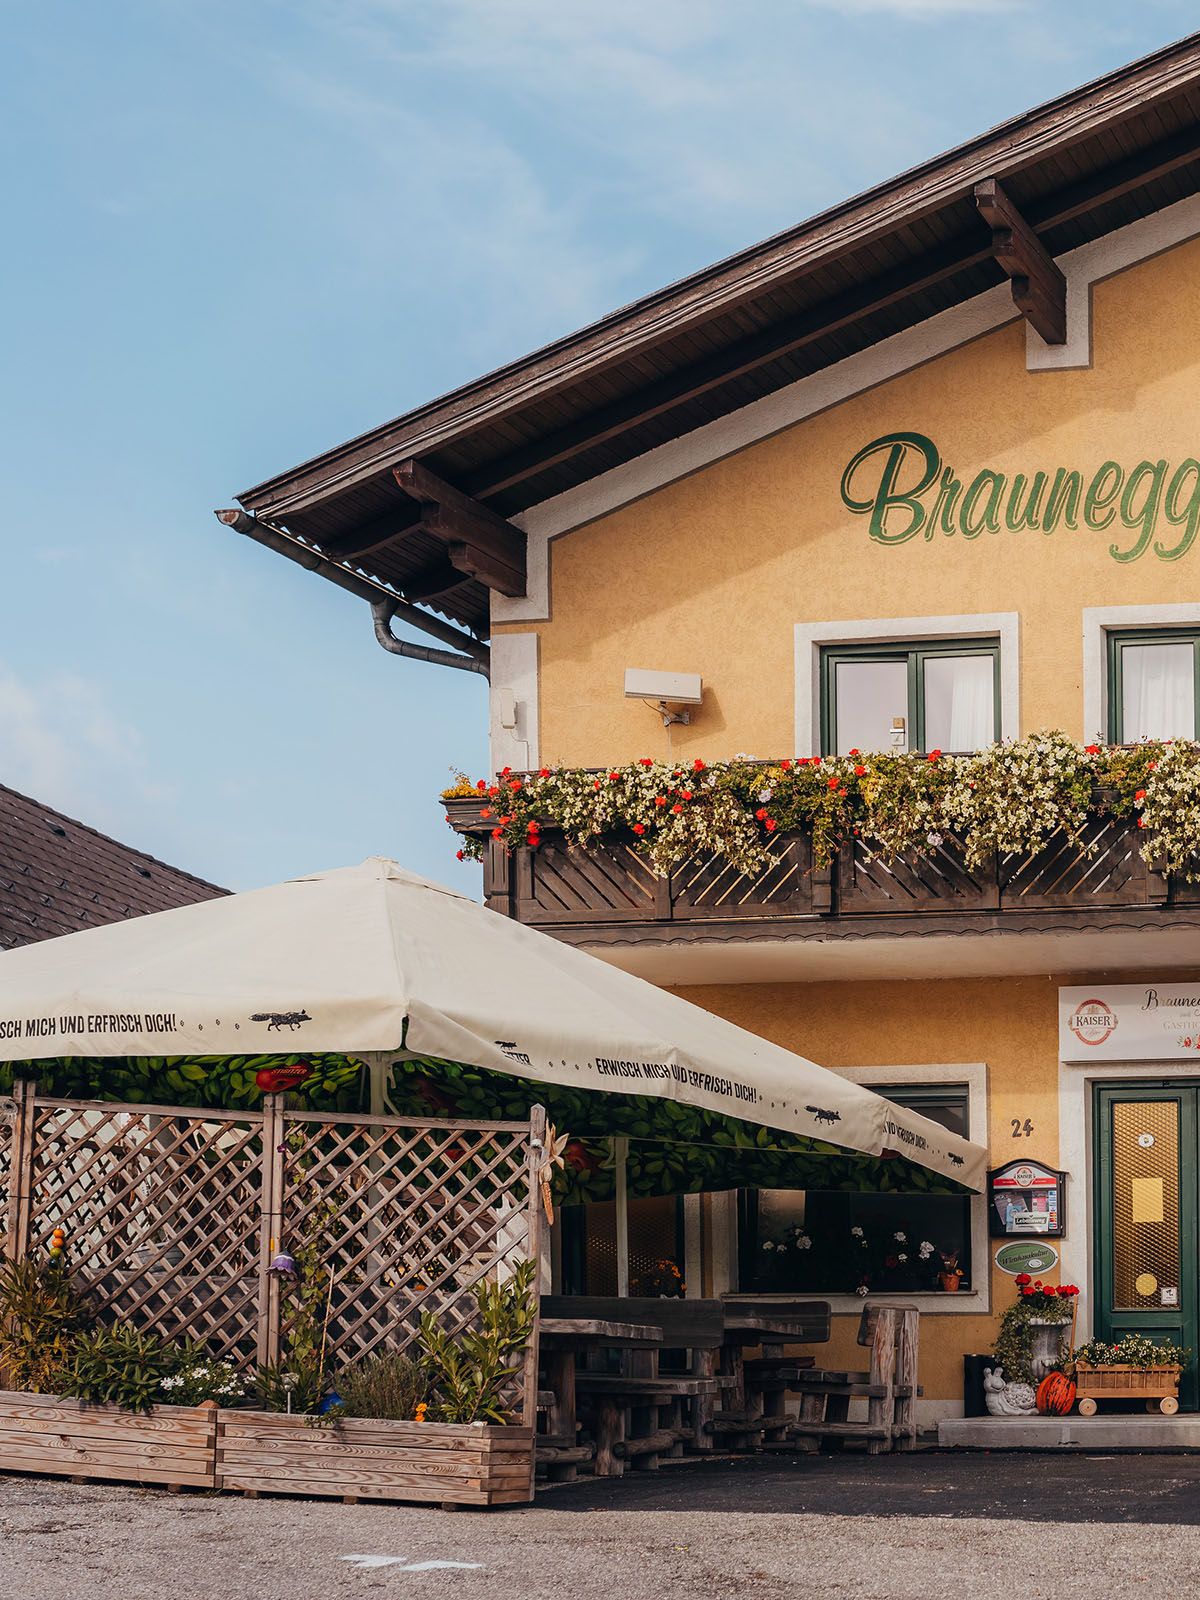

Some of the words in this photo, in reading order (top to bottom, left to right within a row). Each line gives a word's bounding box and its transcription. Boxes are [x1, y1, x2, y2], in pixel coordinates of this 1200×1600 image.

[25, 1017, 57, 1037] MICH
[60, 1015, 85, 1034] UND
[87, 1014, 143, 1033] ERFRISCH
[145, 1013, 177, 1033] DICH!
[1076, 1016, 1110, 1027] KAISER
[595, 1057, 642, 1079] ERWISCH
[641, 1063, 671, 1080] MICH
[688, 1069, 733, 1097] ERFRISCH
[734, 1082, 758, 1104] DICH!
[1010, 1118, 1034, 1138] 24
